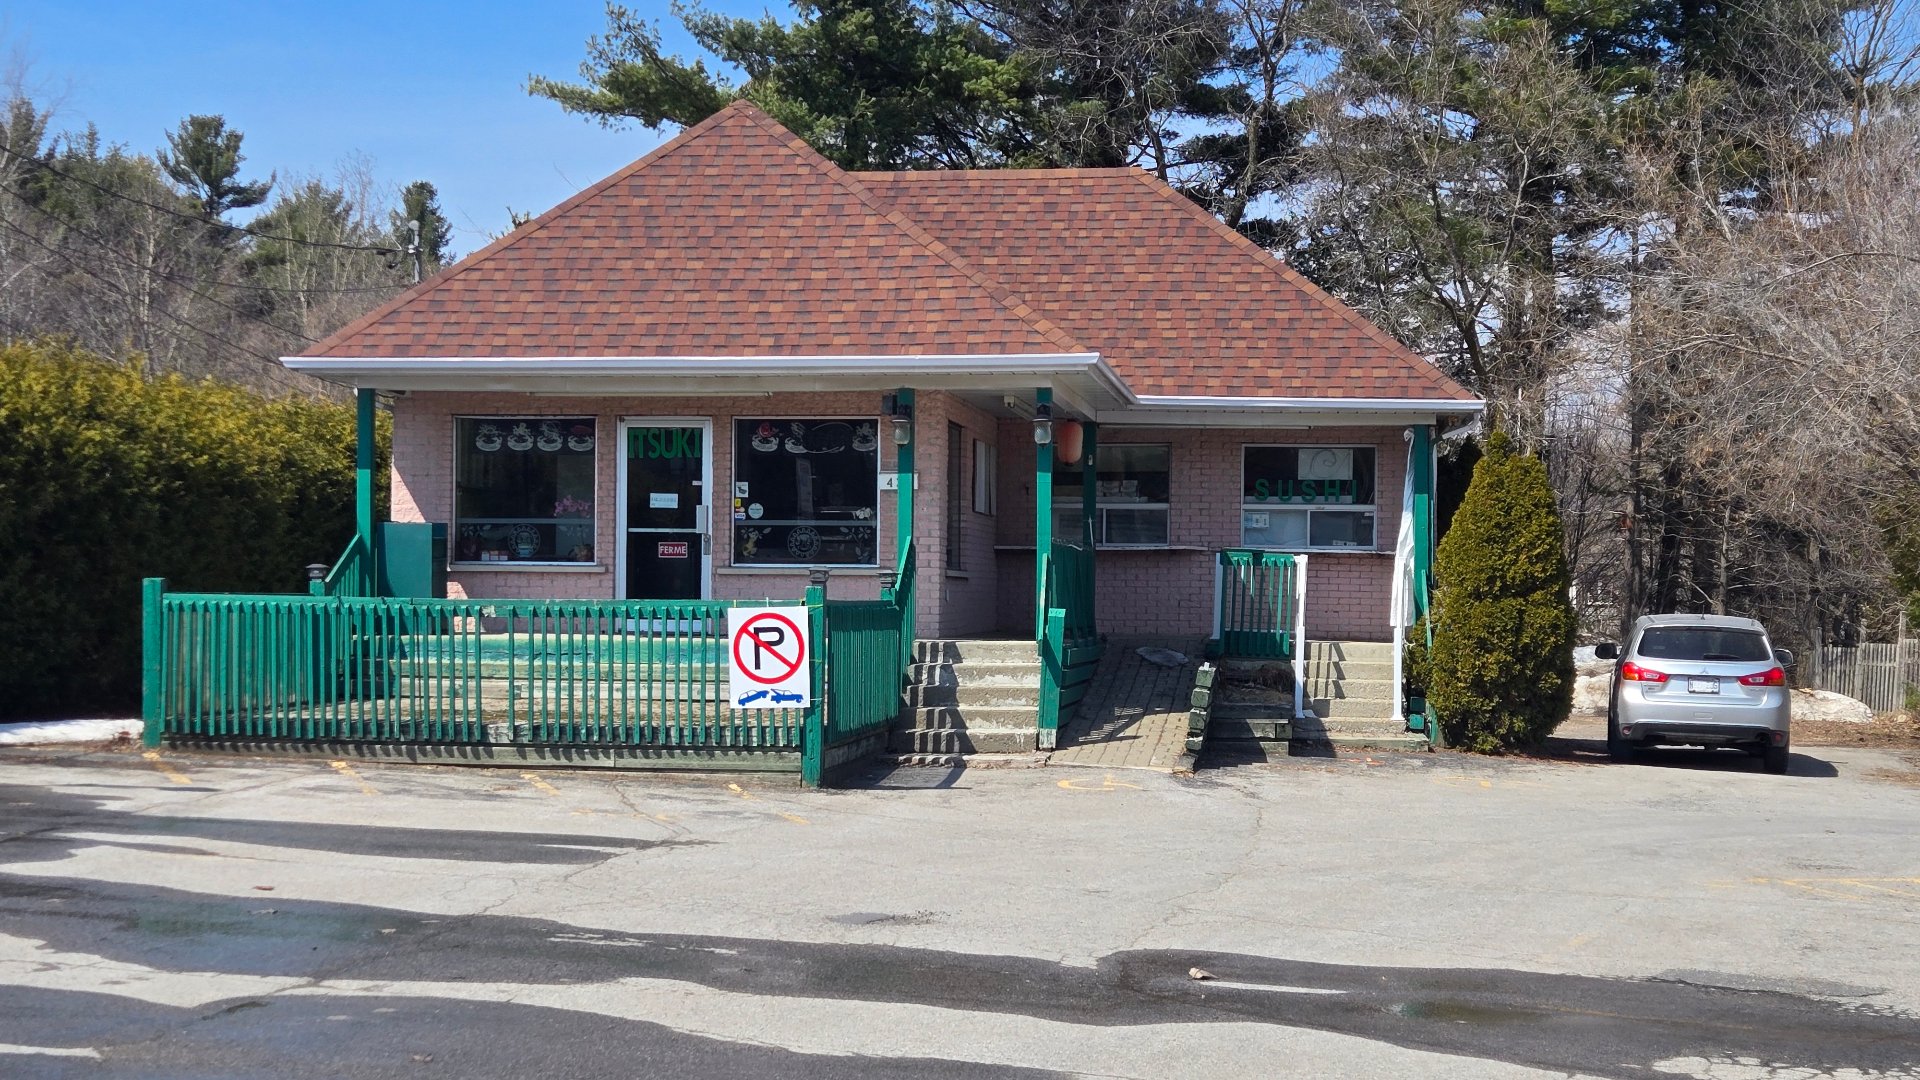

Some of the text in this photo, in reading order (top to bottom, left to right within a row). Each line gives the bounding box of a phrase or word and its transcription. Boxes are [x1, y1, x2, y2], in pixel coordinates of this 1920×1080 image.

[628, 428, 701, 459] ITSUKI
[1254, 478, 1357, 504] SUSHI
[753, 626, 785, 671] P
